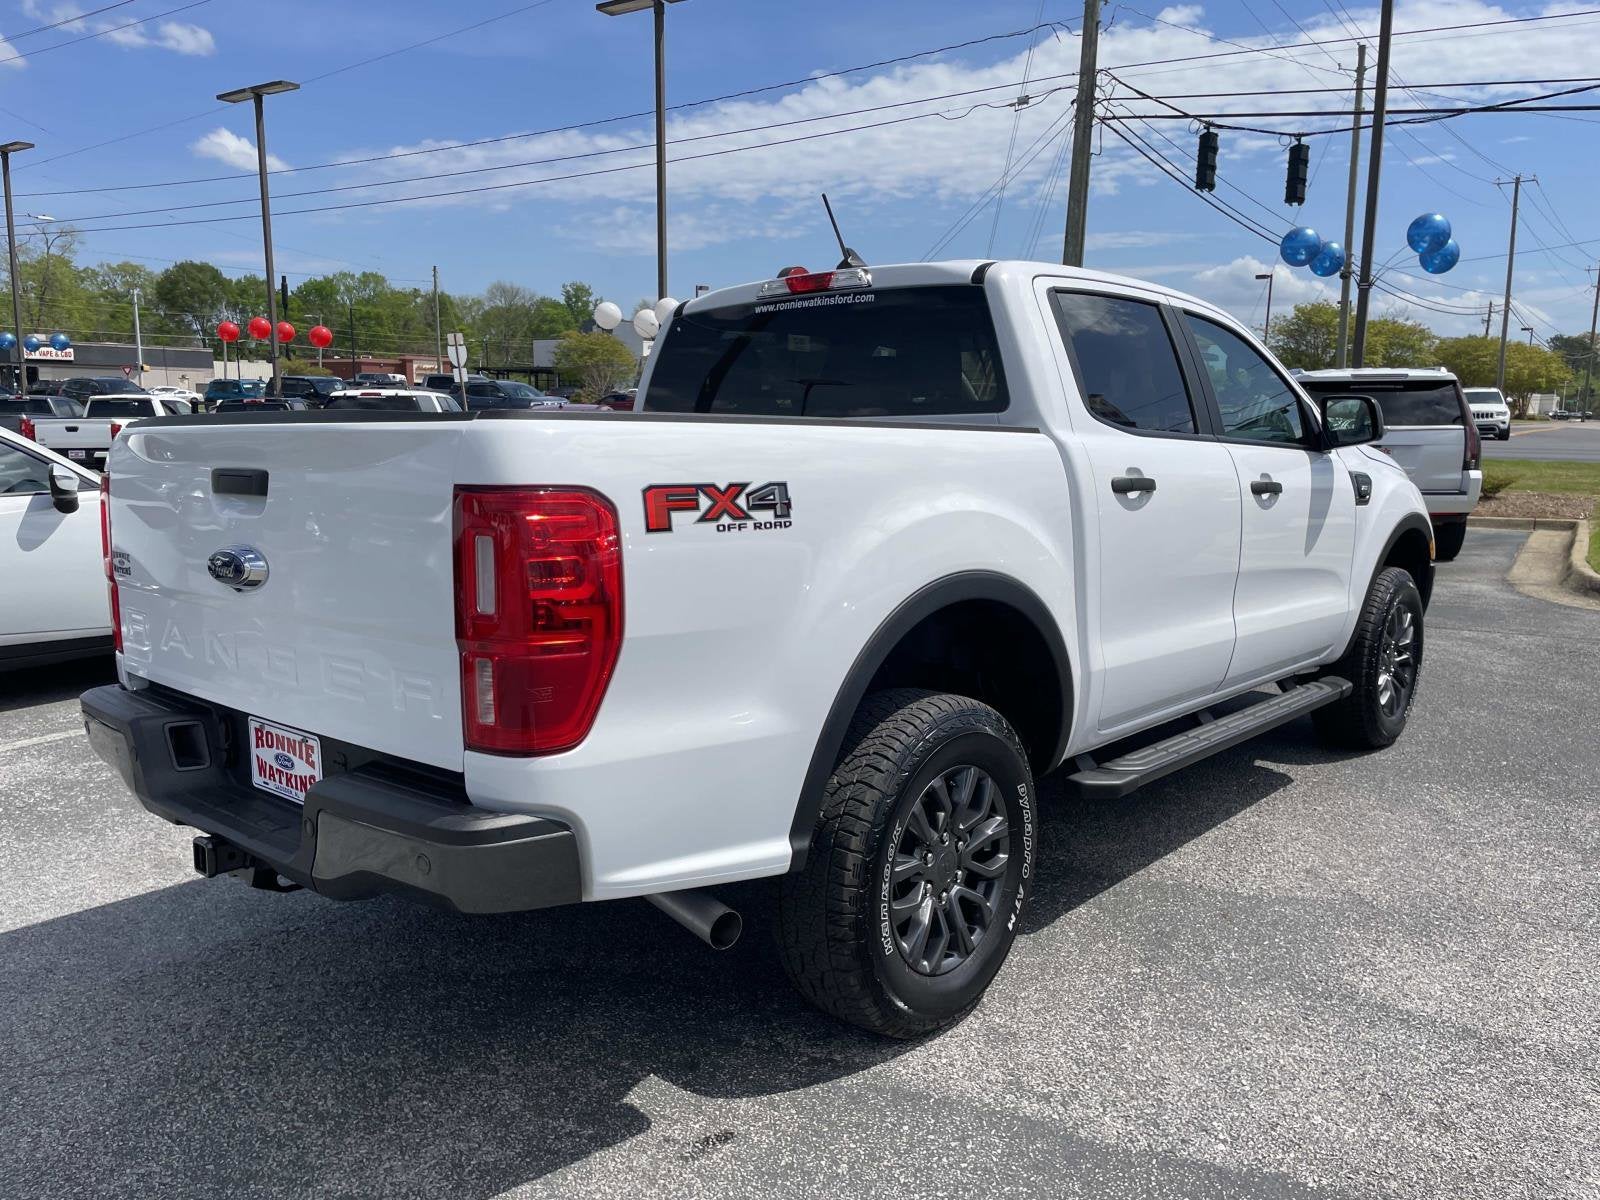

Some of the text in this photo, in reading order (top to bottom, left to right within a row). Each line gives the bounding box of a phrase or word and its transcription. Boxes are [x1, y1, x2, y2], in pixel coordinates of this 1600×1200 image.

[755, 293, 875, 314] www.ronniewatkinsford.com
[641, 481, 793, 535] FX4
[716, 520, 793, 533] OFF ROAD
[125, 606, 446, 720] RANGER
[254, 726, 316, 770] RONNIE
[276, 754, 294, 769] Ford
